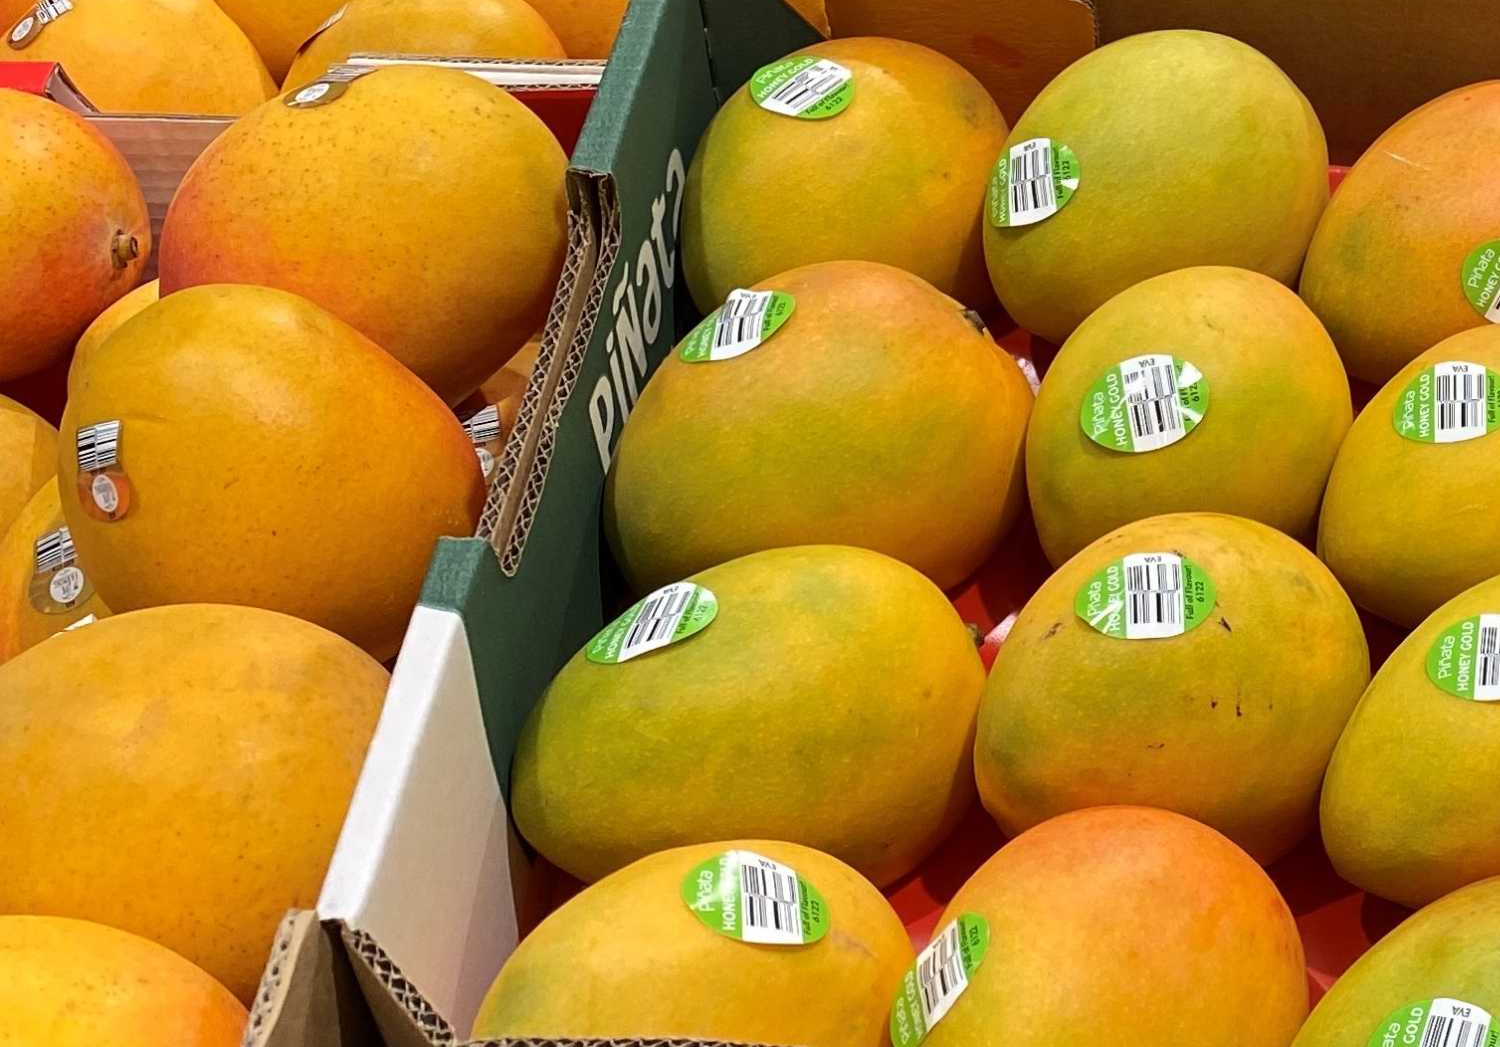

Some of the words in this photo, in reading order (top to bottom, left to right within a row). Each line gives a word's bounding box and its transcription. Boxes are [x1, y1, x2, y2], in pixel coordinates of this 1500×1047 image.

[1476, 272, 1500, 308] HONEY
[1452, 365, 1469, 373] EVA
[1108, 374, 1121, 405] GOLD
[1419, 374, 1429, 403] GOLD
[1419, 404, 1430, 438] HONEY
[1195, 581, 1205, 602] 6122
[1461, 621, 1474, 651] GOLD
[1457, 652, 1471, 692] HONEY
[809, 900, 819, 924] 6122
[1403, 1007, 1424, 1044] GOLD
[1452, 1005, 1471, 1018] EVA
